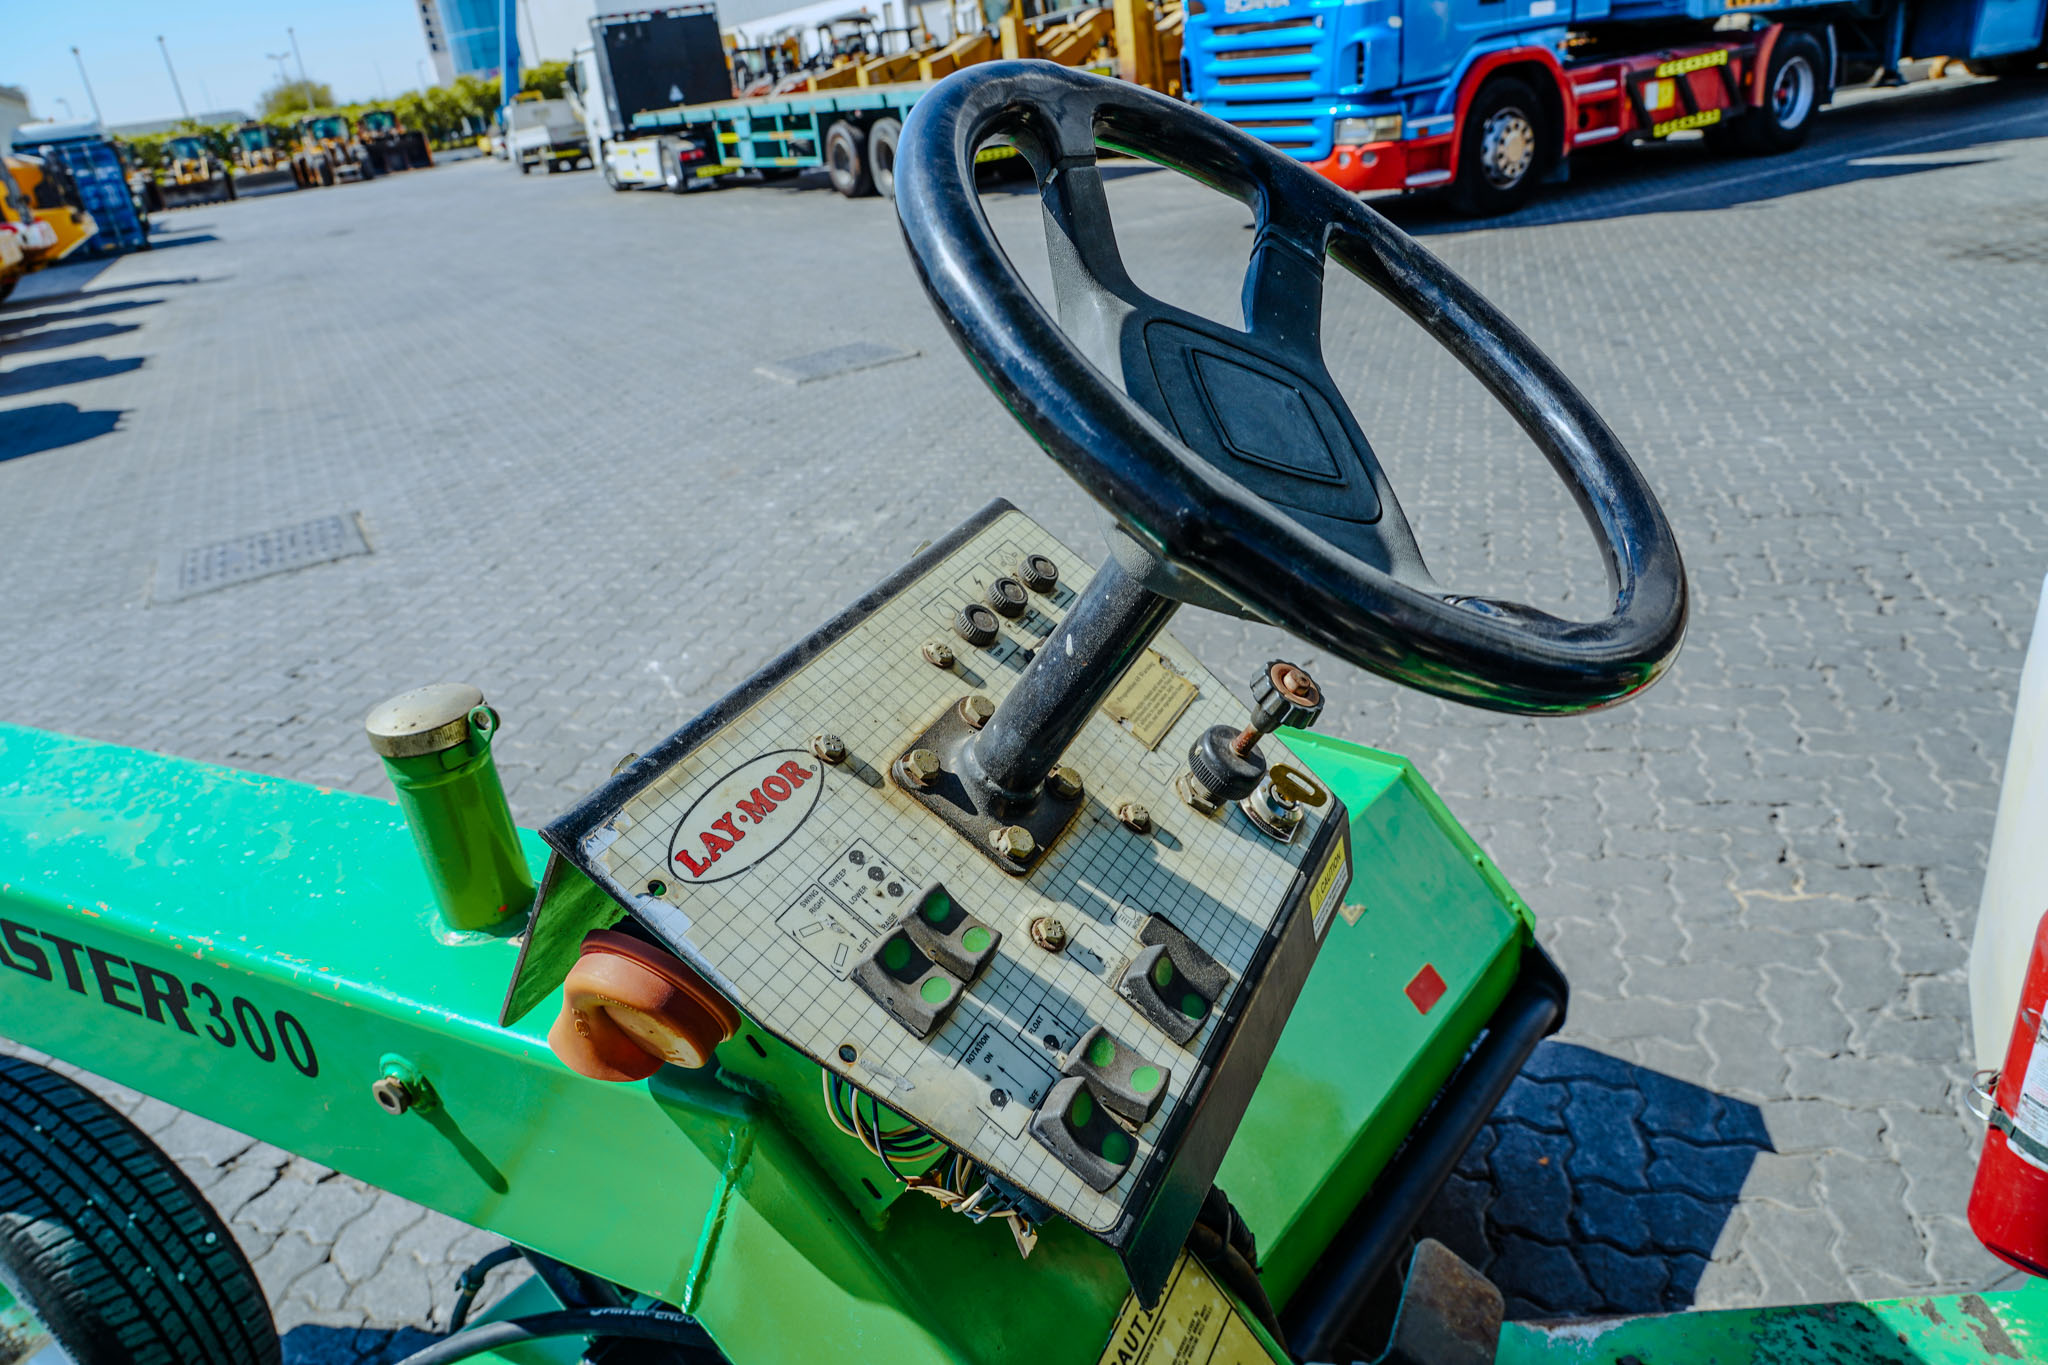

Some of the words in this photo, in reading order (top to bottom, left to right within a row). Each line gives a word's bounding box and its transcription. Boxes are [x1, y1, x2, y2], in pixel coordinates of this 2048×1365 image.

[828, 868, 847, 888] SWEEP
[1320, 850, 1341, 894] CAUTION
[800, 889, 819, 908] SWING
[848, 885, 868, 905] LOWER
[808, 897, 826, 915] RIGHT
[880, 912, 898, 931] RAISE
[857, 937, 871, 953] LEFT
[0, 918, 319, 1079] STER300
[1028, 1014, 1044, 1035] FLOAT
[965, 1033, 990, 1065] ROTATION
[983, 1052, 994, 1064] ON
[1028, 1089, 1040, 1104] OFF
